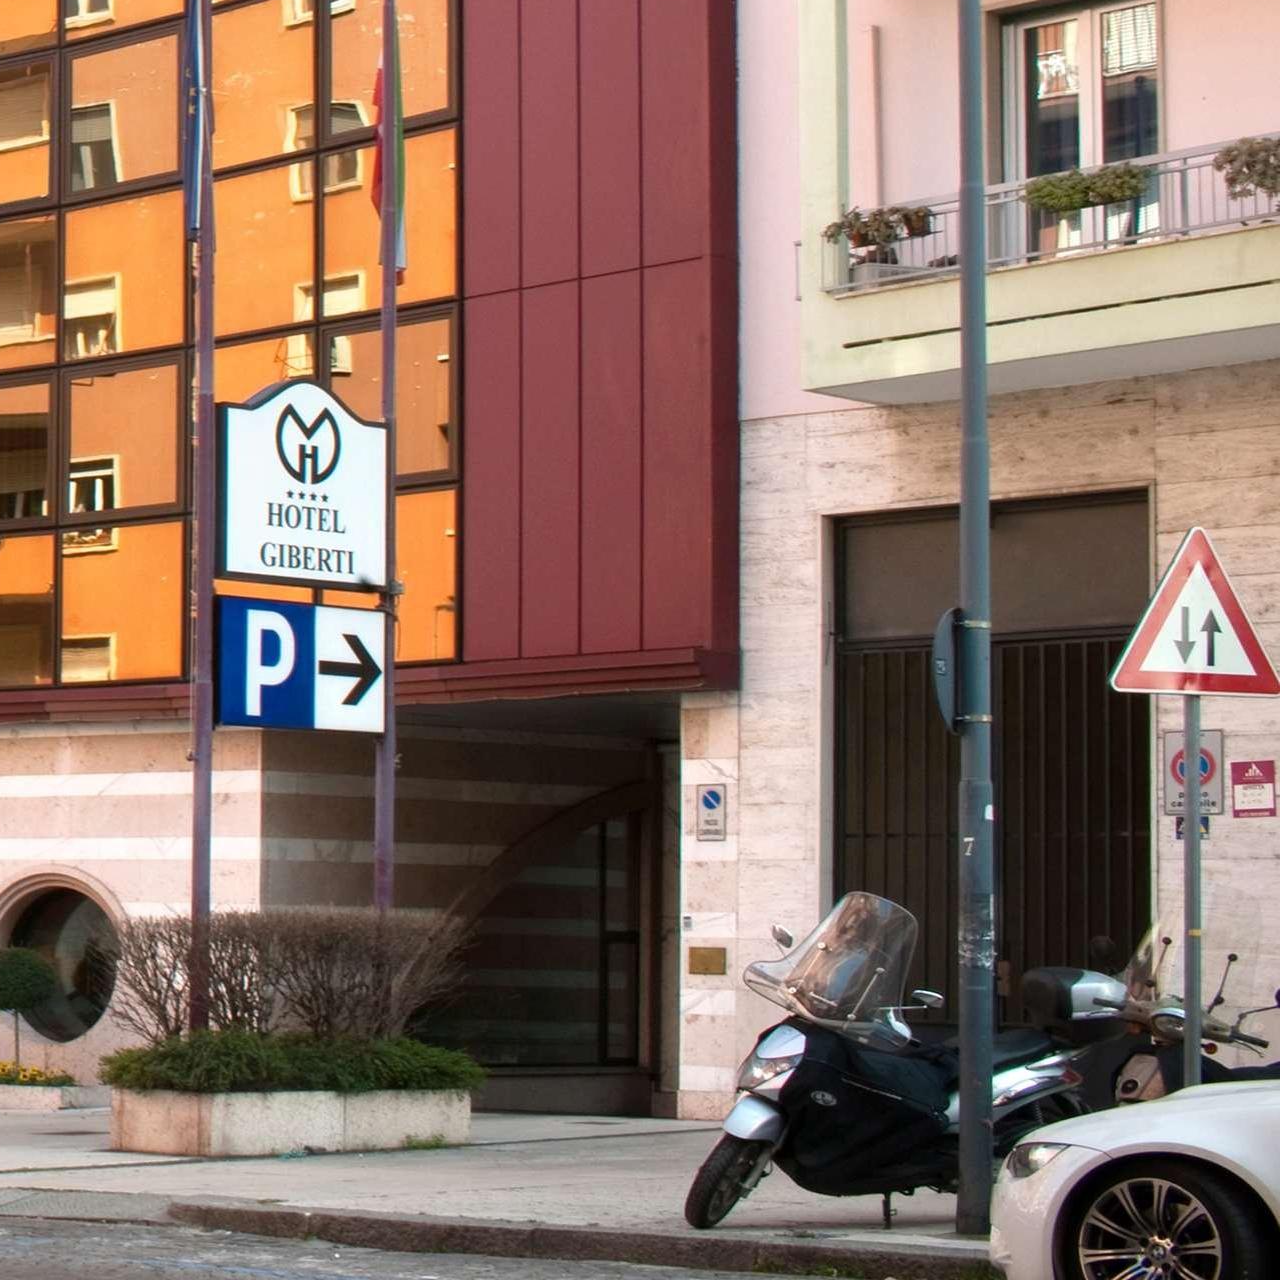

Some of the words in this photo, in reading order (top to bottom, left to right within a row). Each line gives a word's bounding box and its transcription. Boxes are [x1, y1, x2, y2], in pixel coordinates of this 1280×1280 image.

[266, 501, 346, 535] HOTEL
[259, 541, 355, 575] GIBERTI
[245, 608, 296, 717] P
